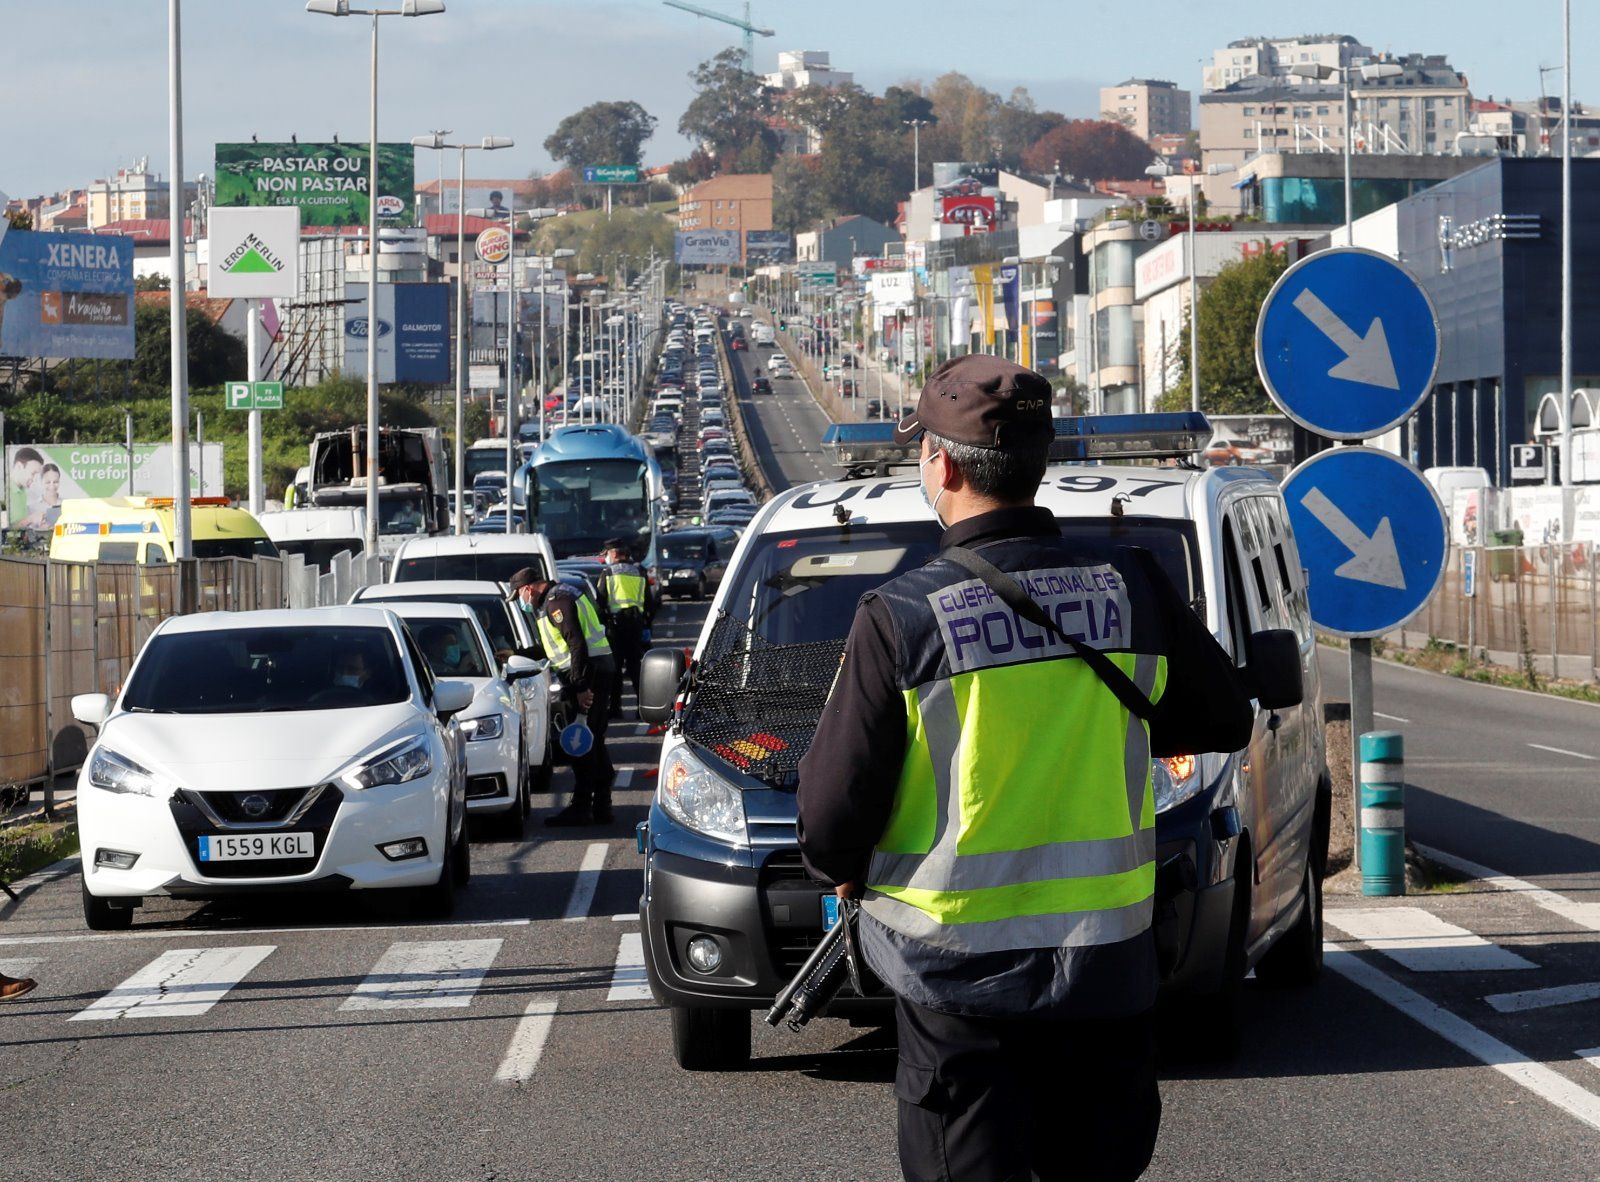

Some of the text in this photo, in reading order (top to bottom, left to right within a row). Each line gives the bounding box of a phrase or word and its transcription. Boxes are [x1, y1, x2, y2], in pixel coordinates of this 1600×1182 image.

[263, 157, 361, 172] PASTAR OU
[257, 177, 368, 192] NON PASTAR
[276, 196, 291, 205] ESA
[307, 196, 349, 205] CUESTIÓN
[378, 199, 401, 209] ARSA
[47, 243, 121, 269] XENERA
[219, 233, 285, 272] LEROY MERLIN
[482, 241, 509, 257] KING
[881, 278, 899, 288] LUZ
[232, 385, 248, 406] P
[1017, 399, 1044, 410] CNP
[1521, 447, 1536, 467] P
[71, 467, 86, 480] tu
[939, 584, 998, 614] CUERP
[1092, 572, 1120, 592] DE
[948, 598, 1123, 661] POLICIA
[217, 837, 308, 857] 1559 KGL
